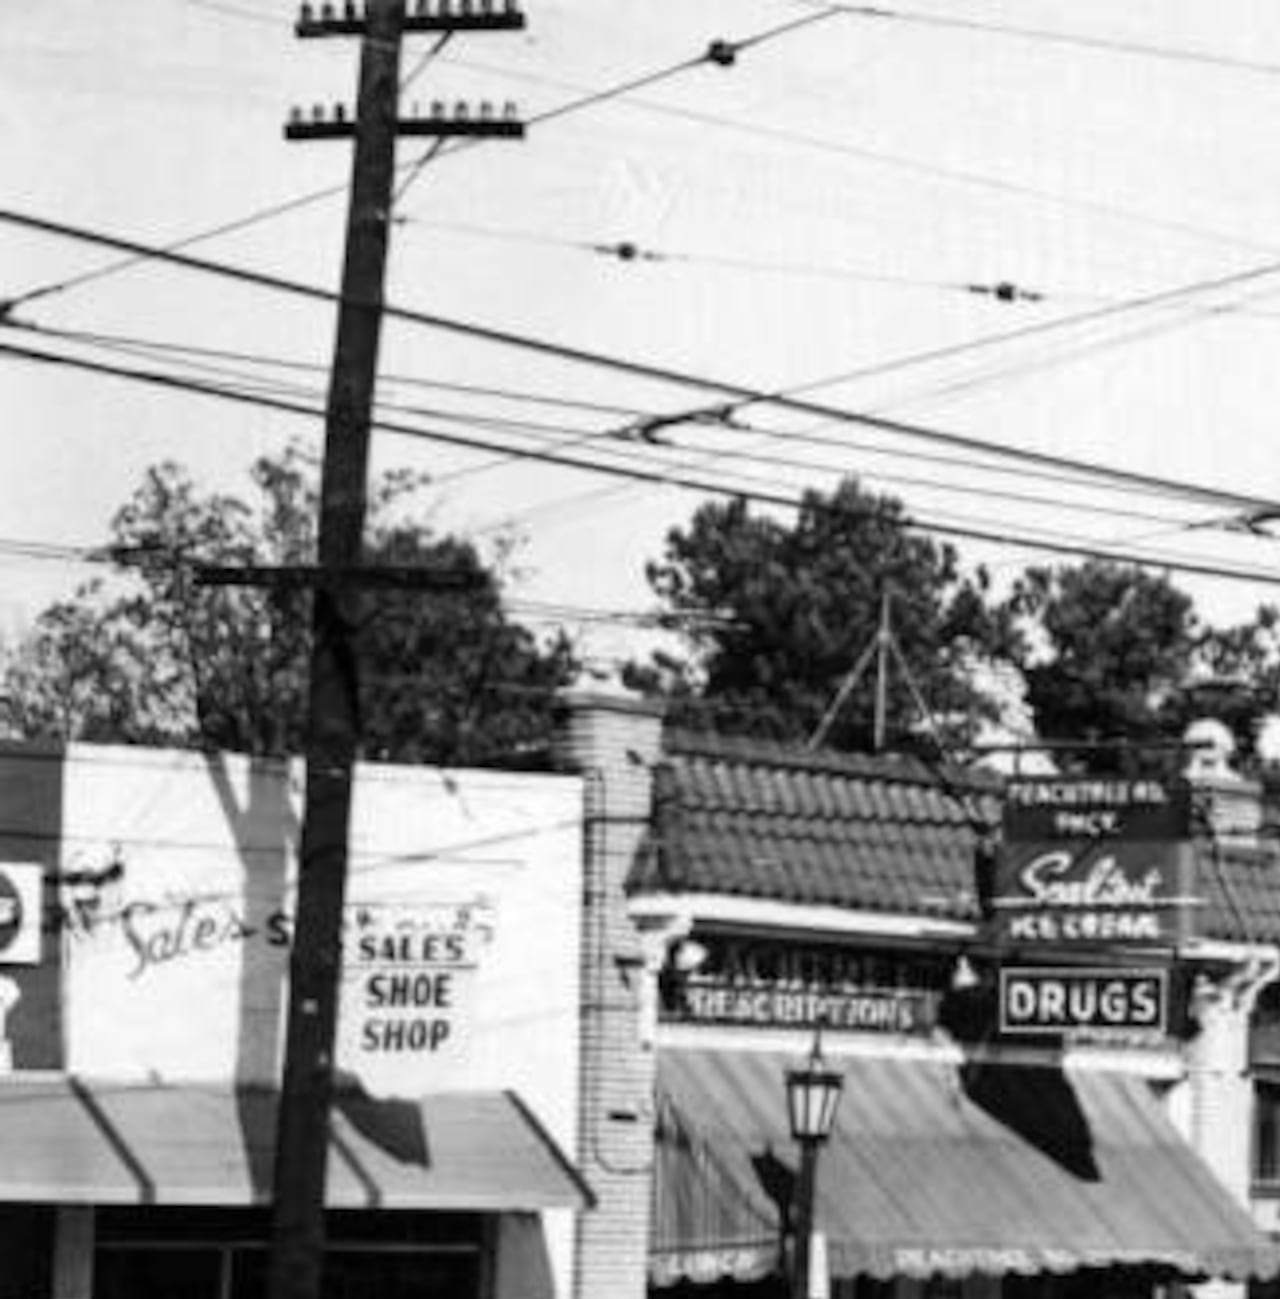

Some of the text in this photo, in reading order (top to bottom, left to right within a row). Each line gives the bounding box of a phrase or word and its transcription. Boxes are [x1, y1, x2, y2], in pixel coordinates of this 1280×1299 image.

[1010, 912, 1160, 938] ICE CREAM
[358, 932, 465, 962] SALES
[366, 973, 452, 1008] SHOE
[1008, 980, 1157, 1022] DRUGS
[361, 1017, 450, 1053] SHOP
